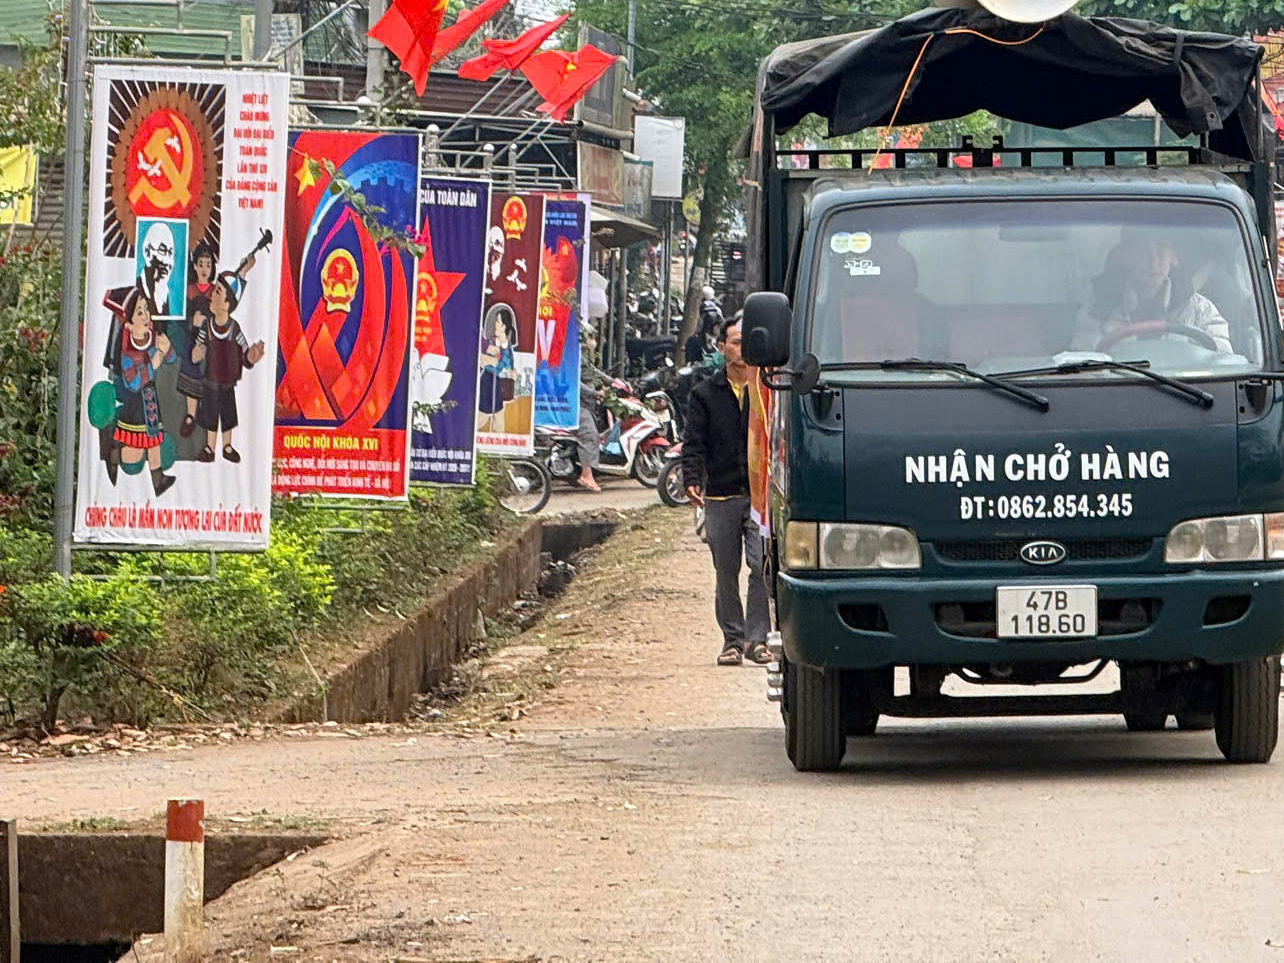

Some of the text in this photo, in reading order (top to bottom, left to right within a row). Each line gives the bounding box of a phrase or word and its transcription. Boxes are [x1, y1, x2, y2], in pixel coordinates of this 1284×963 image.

[437, 187, 459, 206] TOÀN
[460, 189, 477, 207] DÂN
[283, 433, 379, 450] QUỐC HỘI KHÓA XVI
[905, 442, 1170, 487] NHẬN CHỞ HÀNG
[157, 507, 173, 530] NON
[1028, 547, 1059, 559] KIA
[1026, 590, 1068, 611] 47B
[1011, 613, 1086, 634] 118.60
